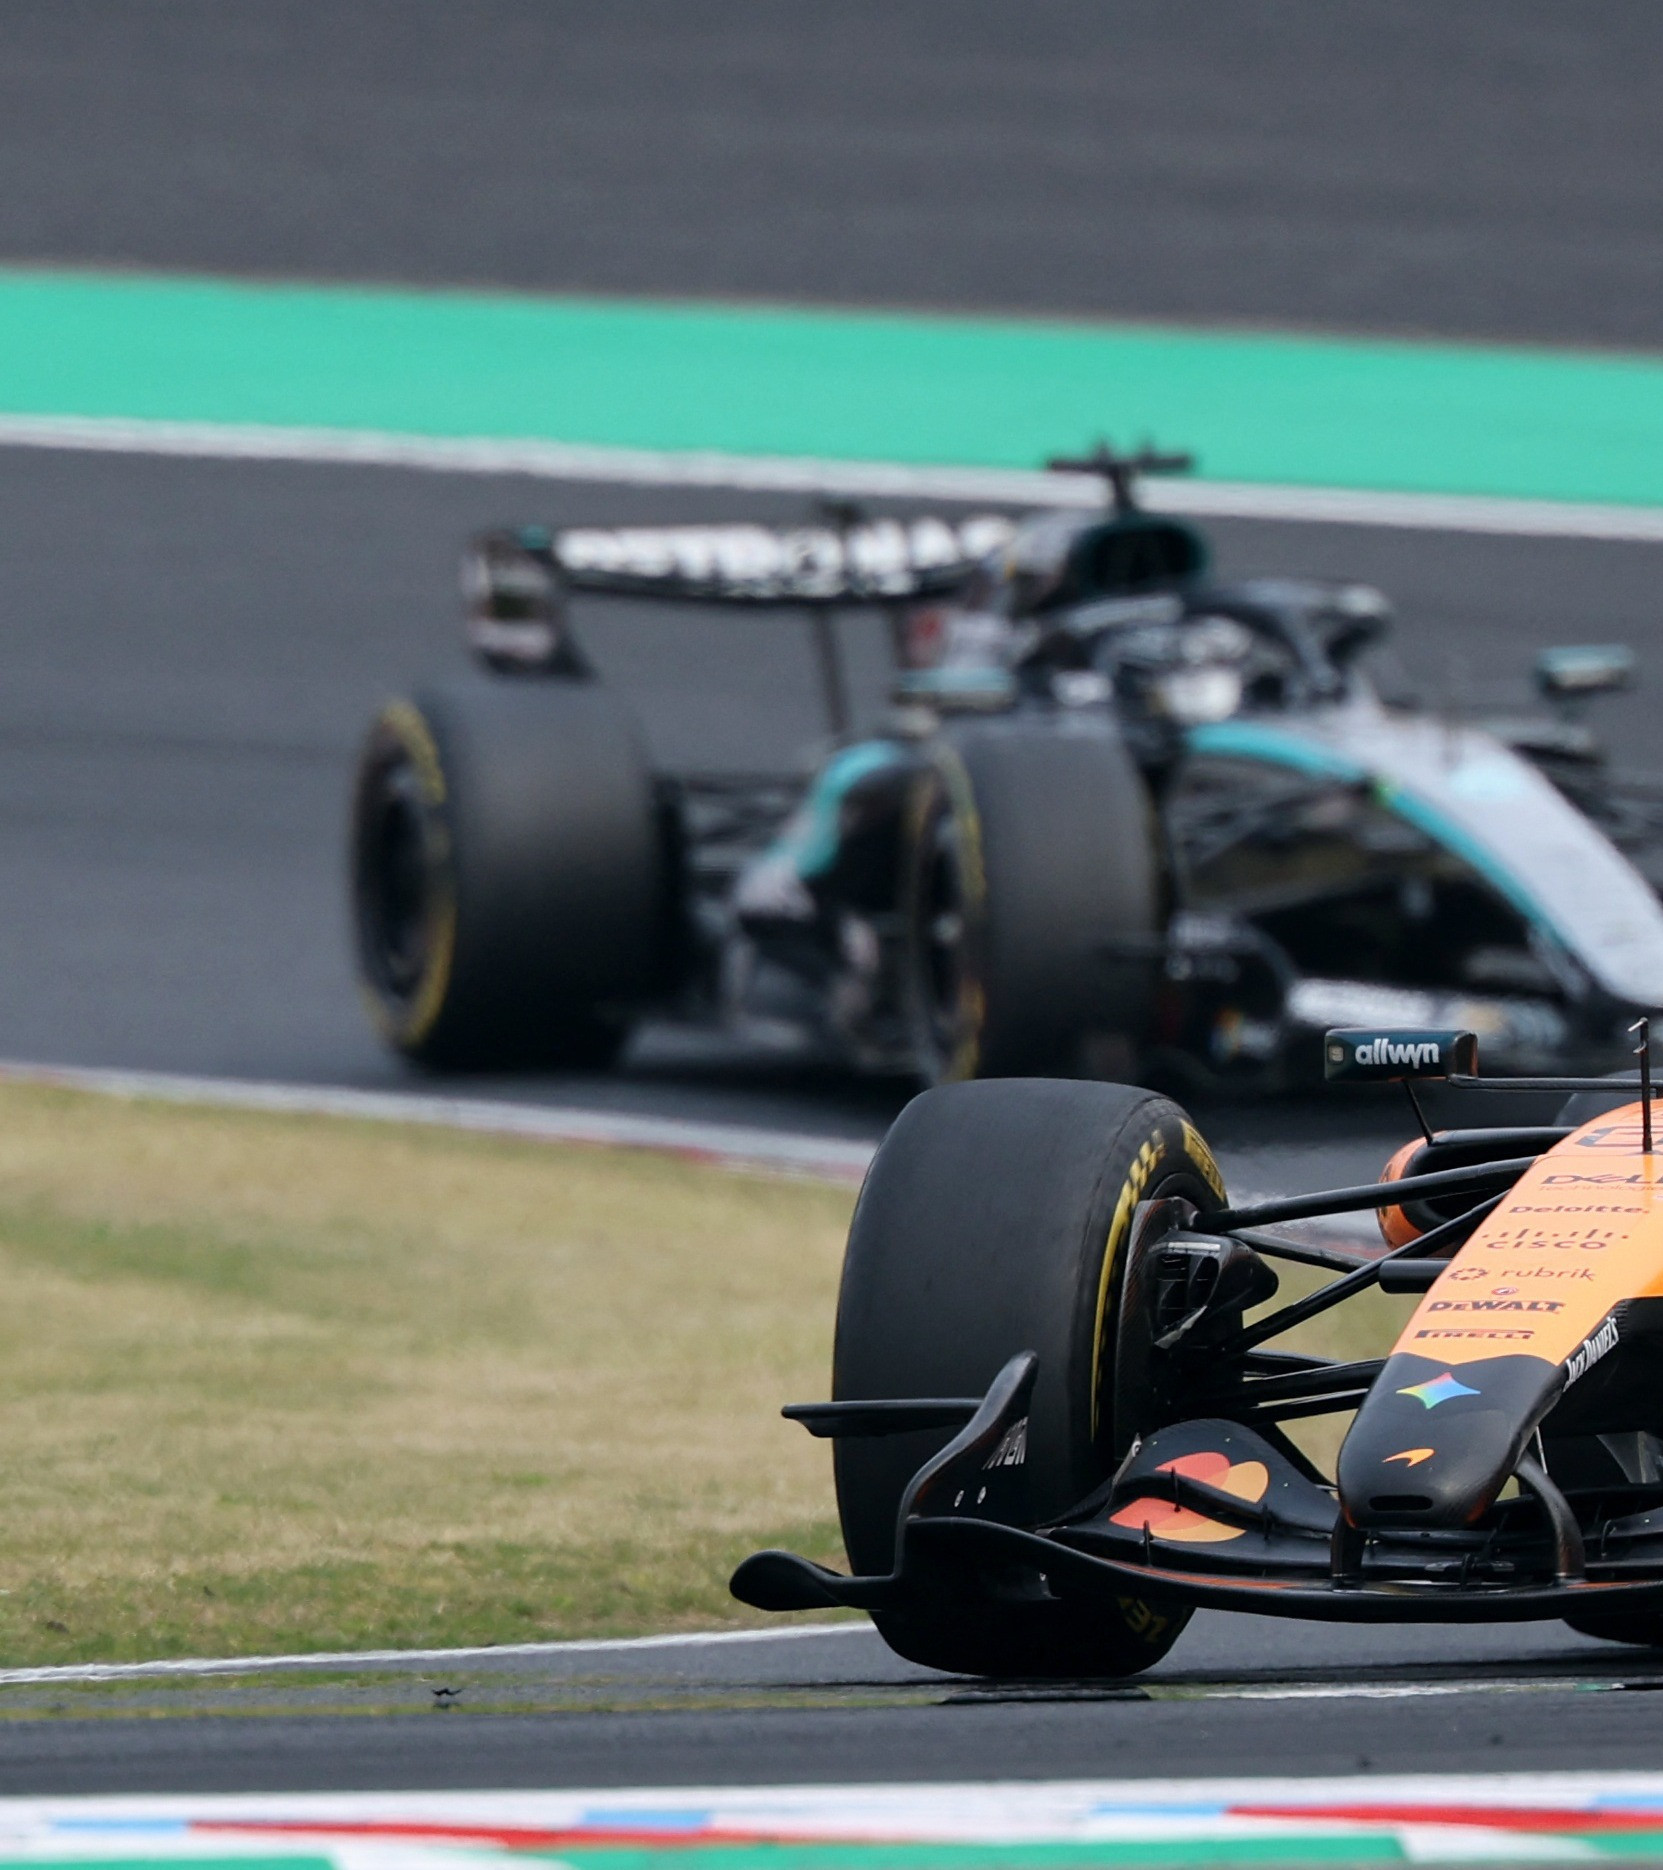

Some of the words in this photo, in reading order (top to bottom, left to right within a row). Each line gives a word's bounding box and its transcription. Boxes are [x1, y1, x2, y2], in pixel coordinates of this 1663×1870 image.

[1355, 1038, 1440, 1070] allwyn
[1500, 1266, 1597, 1283] rubrik
[1413, 1328, 1536, 1341] PIRELLI
